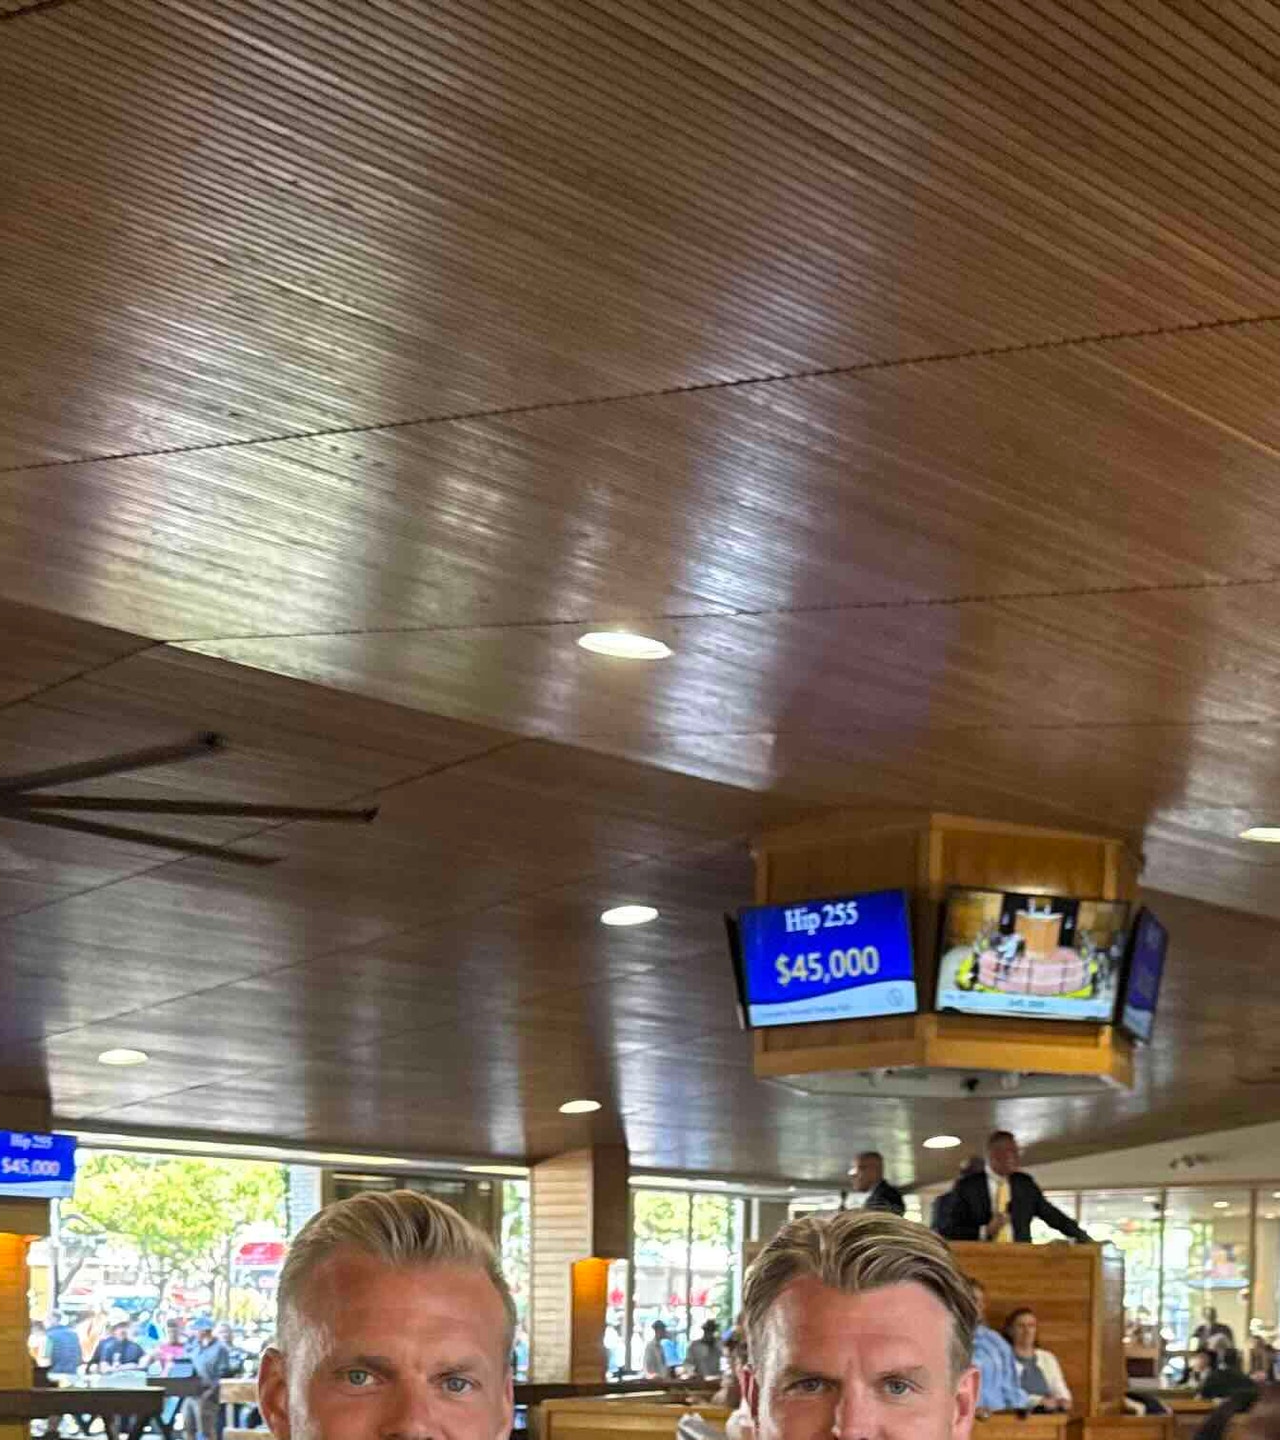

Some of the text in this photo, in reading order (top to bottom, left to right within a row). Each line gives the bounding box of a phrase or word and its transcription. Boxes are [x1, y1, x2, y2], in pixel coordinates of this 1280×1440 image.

[784, 901, 859, 935] Hip 255
[775, 945, 880, 987] $45,000
[1, 1156, 61, 1177] $45,000
